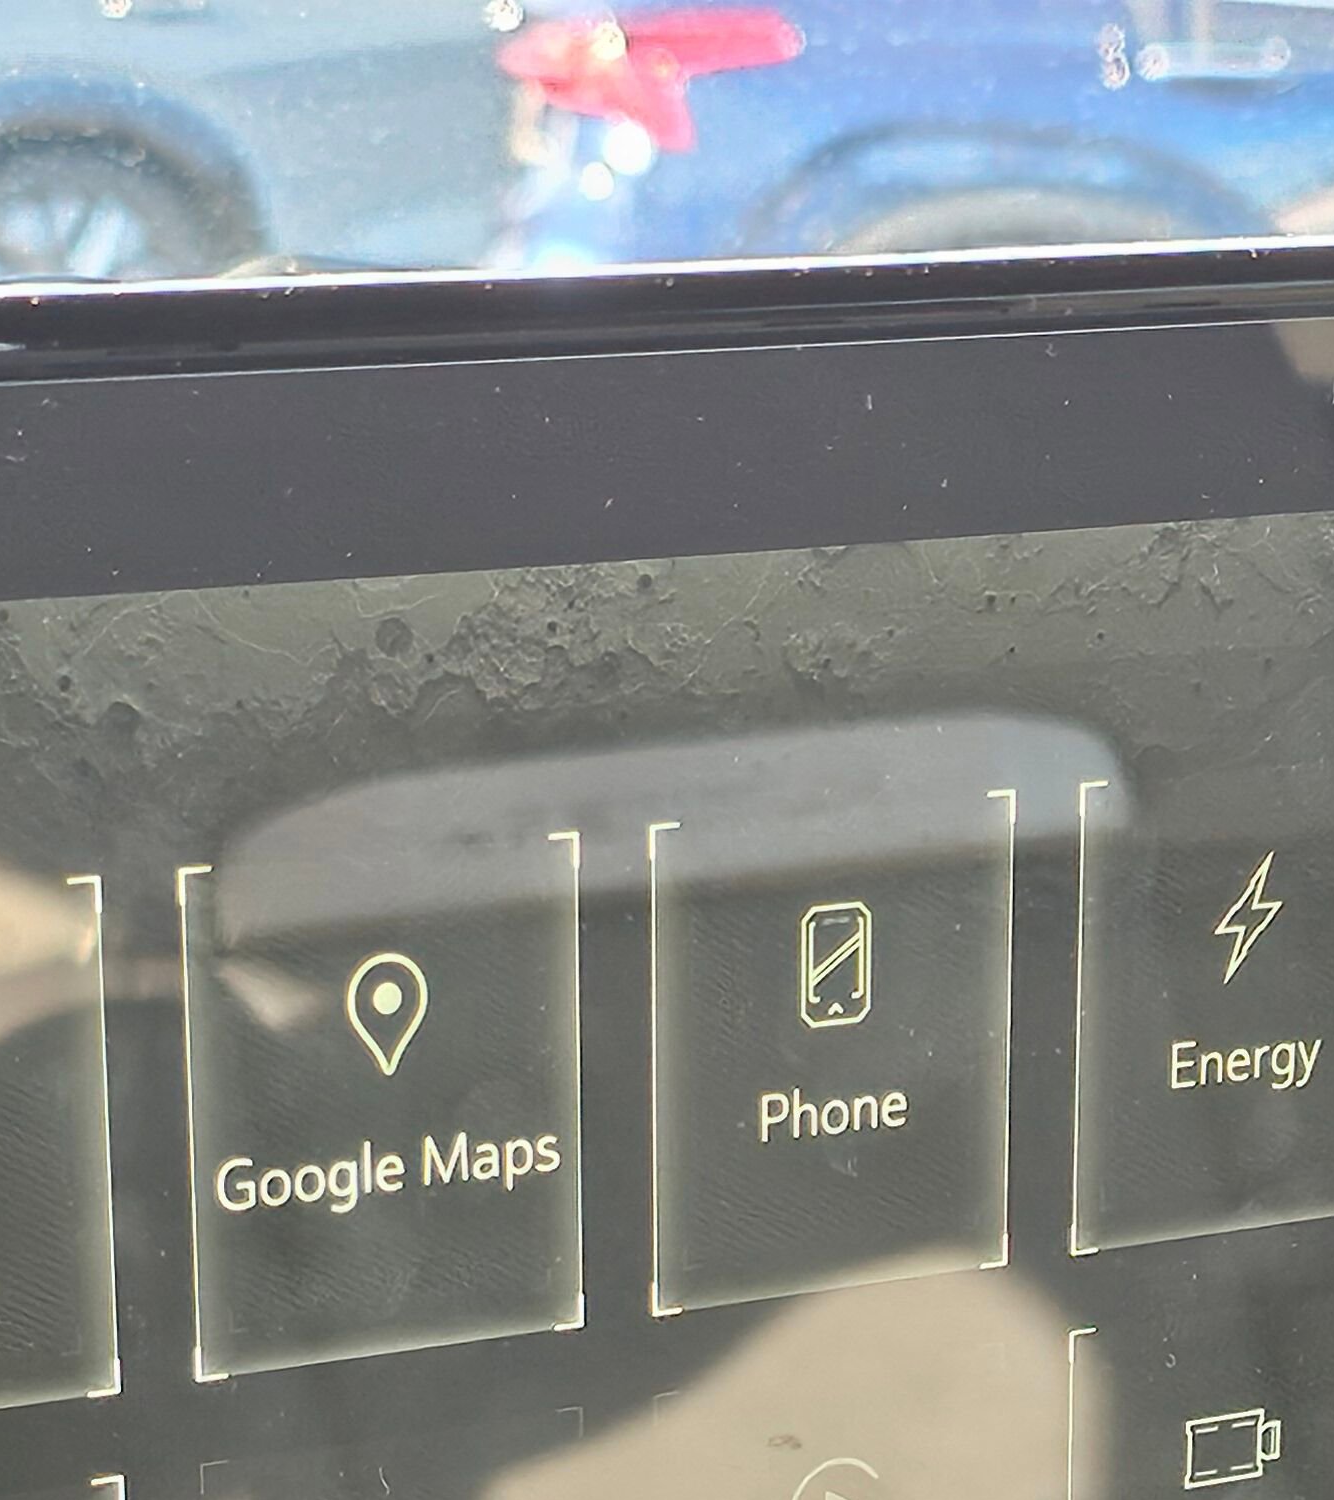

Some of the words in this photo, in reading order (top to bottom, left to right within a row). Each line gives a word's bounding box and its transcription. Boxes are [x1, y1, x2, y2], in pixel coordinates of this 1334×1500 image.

[1169, 1037, 1323, 1090] Energy
[758, 1086, 909, 1143] Phone
[215, 1138, 405, 1214] Google
[420, 1129, 562, 1191] Maps
